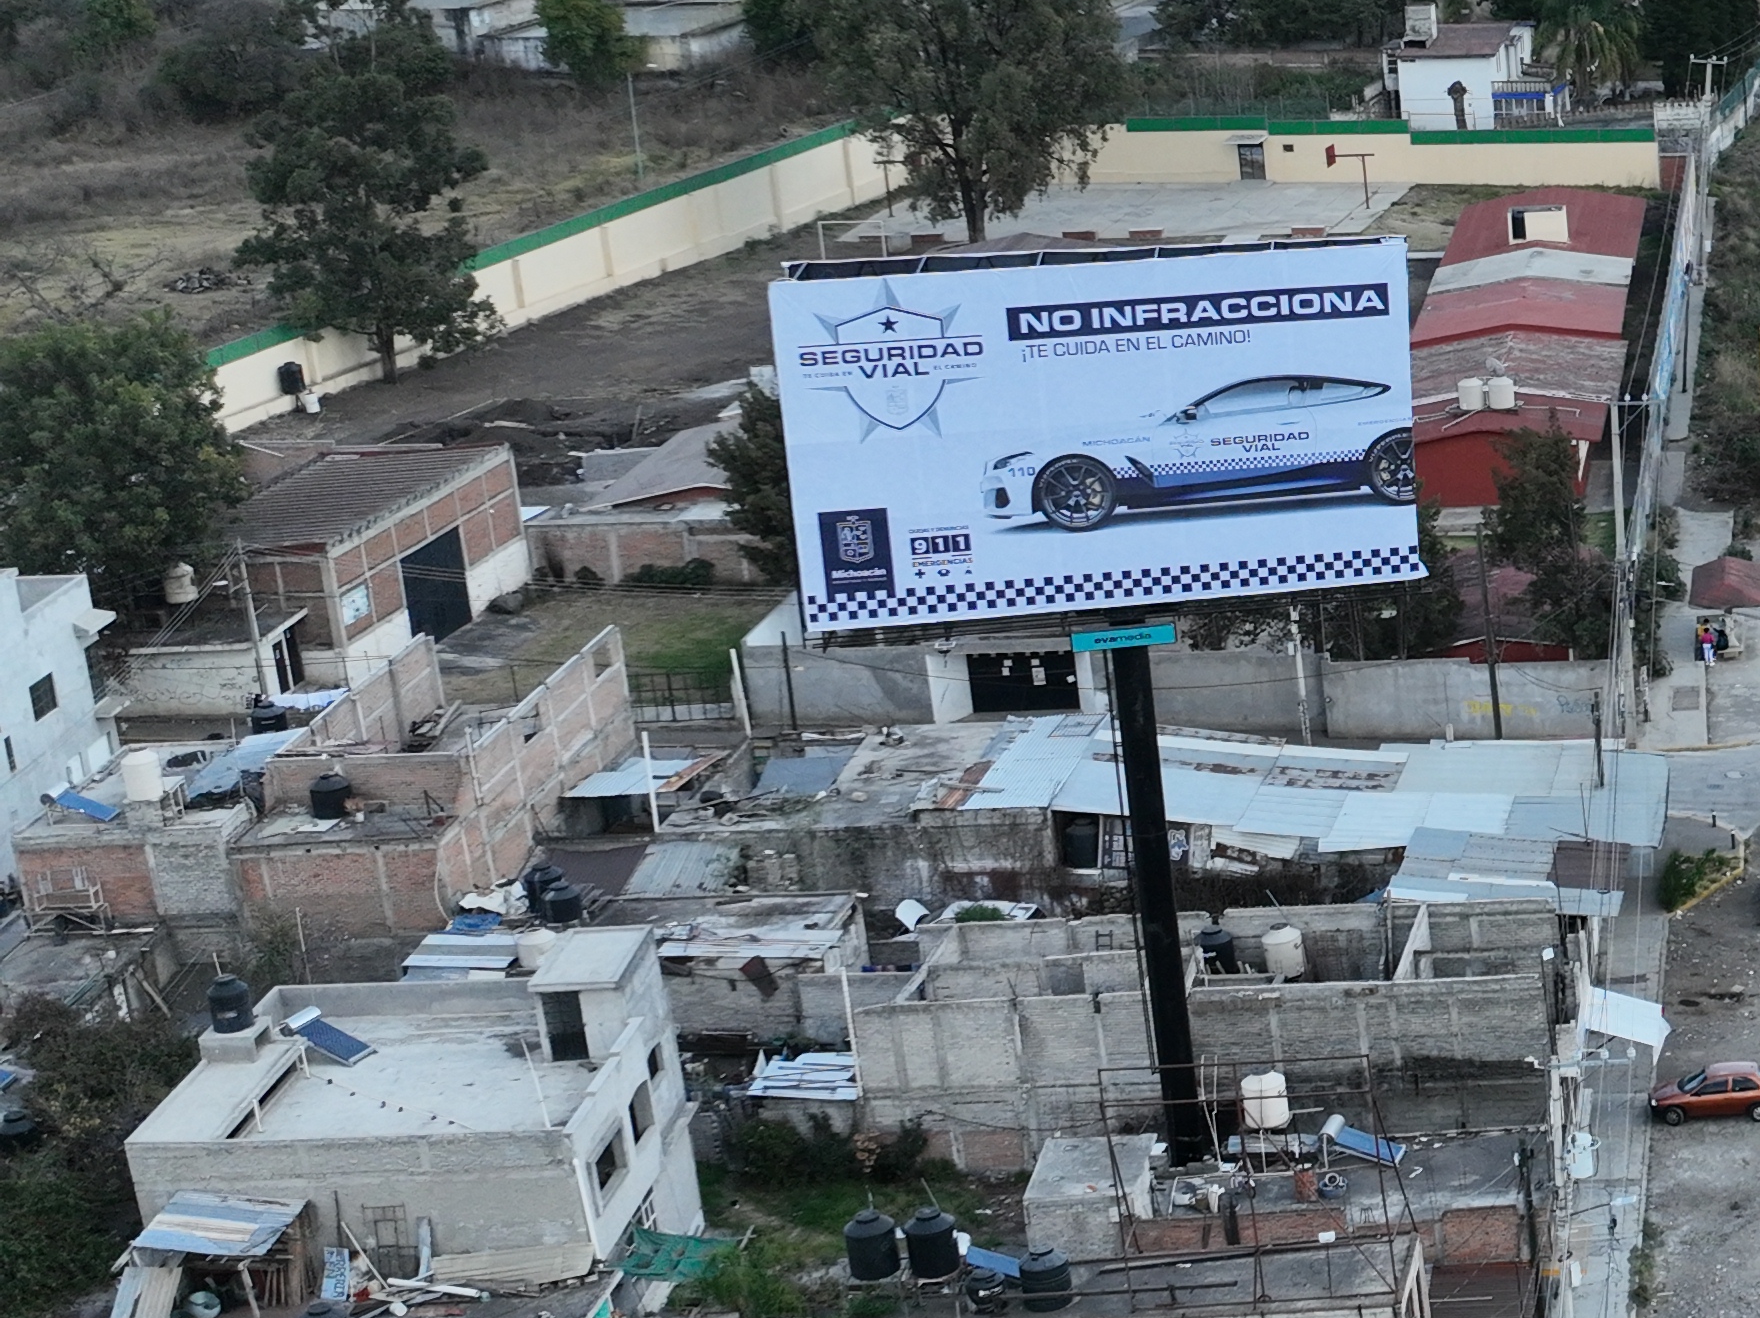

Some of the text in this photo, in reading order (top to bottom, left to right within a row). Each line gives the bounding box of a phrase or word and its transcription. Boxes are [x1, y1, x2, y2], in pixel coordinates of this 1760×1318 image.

[1019, 289, 1386, 334] NO INFRACCIONA
[798, 341, 985, 367] SEGURIDAD
[1021, 329, 1252, 363] ¡TE CUIDA EN EL CAMINO!
[858, 361, 930, 379] VIAL
[1209, 430, 1310, 448] SEGURIDAD
[1241, 442, 1281, 454] VIAL
[1007, 465, 1036, 478] 110
[911, 535, 967, 556] 911
[911, 557, 974, 568] EMERGENCIAS
[831, 567, 887, 580] Michoacán
